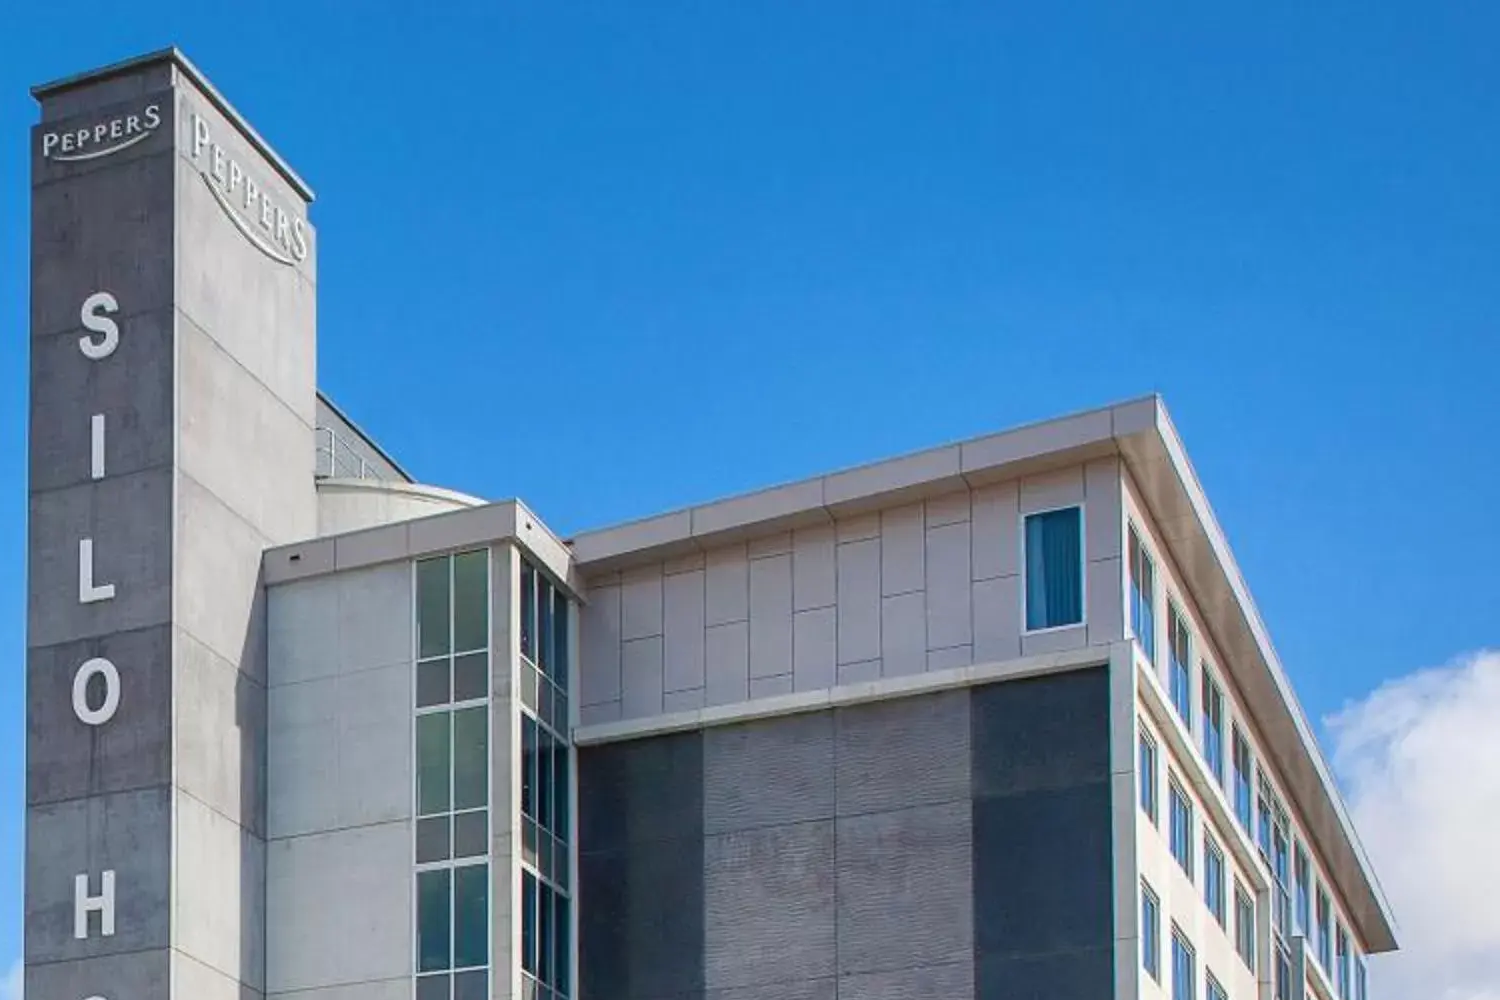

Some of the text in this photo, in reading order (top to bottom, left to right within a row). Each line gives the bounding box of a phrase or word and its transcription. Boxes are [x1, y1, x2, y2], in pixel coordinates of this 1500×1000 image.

[43, 105, 161, 157] PEPPERS
[190, 113, 307, 262] PEPPERS
[71, 291, 121, 726] SILO
